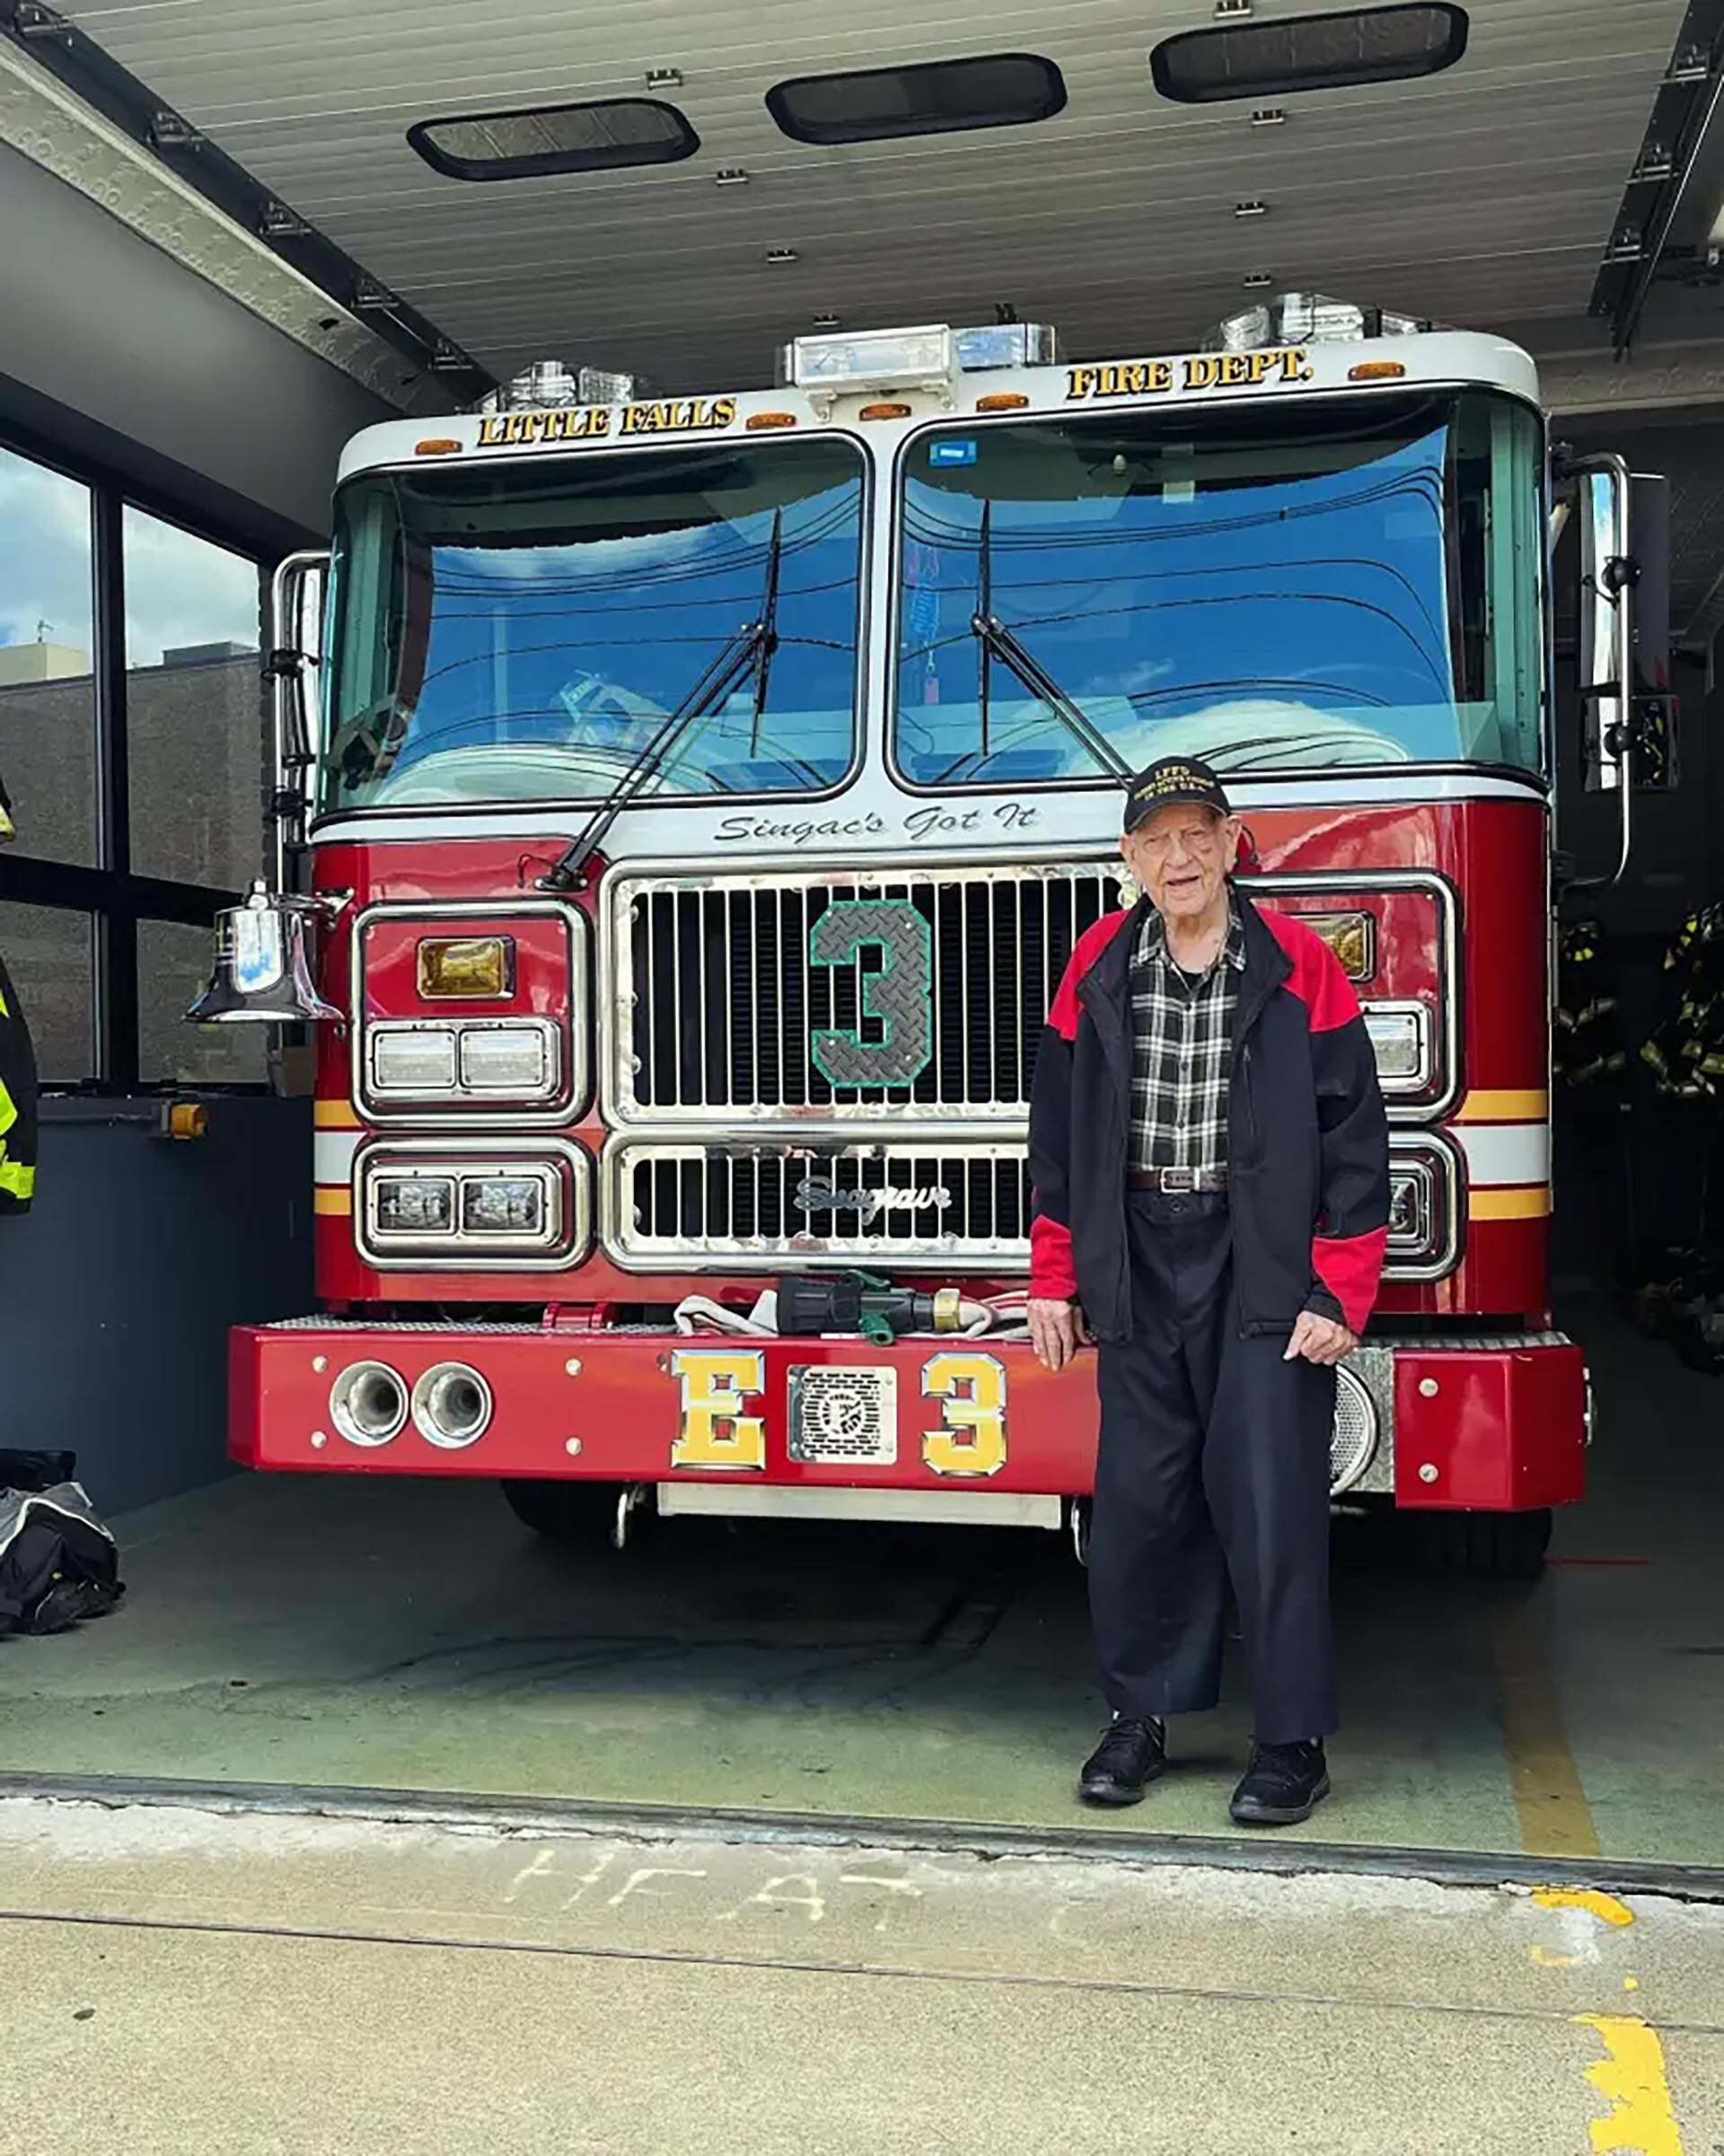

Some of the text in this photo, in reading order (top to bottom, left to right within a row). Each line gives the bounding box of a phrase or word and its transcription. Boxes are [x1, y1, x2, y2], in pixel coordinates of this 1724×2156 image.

[1066, 346, 1315, 400] FIRE DEPT.
[477, 393, 738, 447] LITTLE FALLS
[714, 802, 1038, 845] Singac's Got It
[810, 898, 933, 1088] 3
[671, 1349, 1007, 1477] E 3
